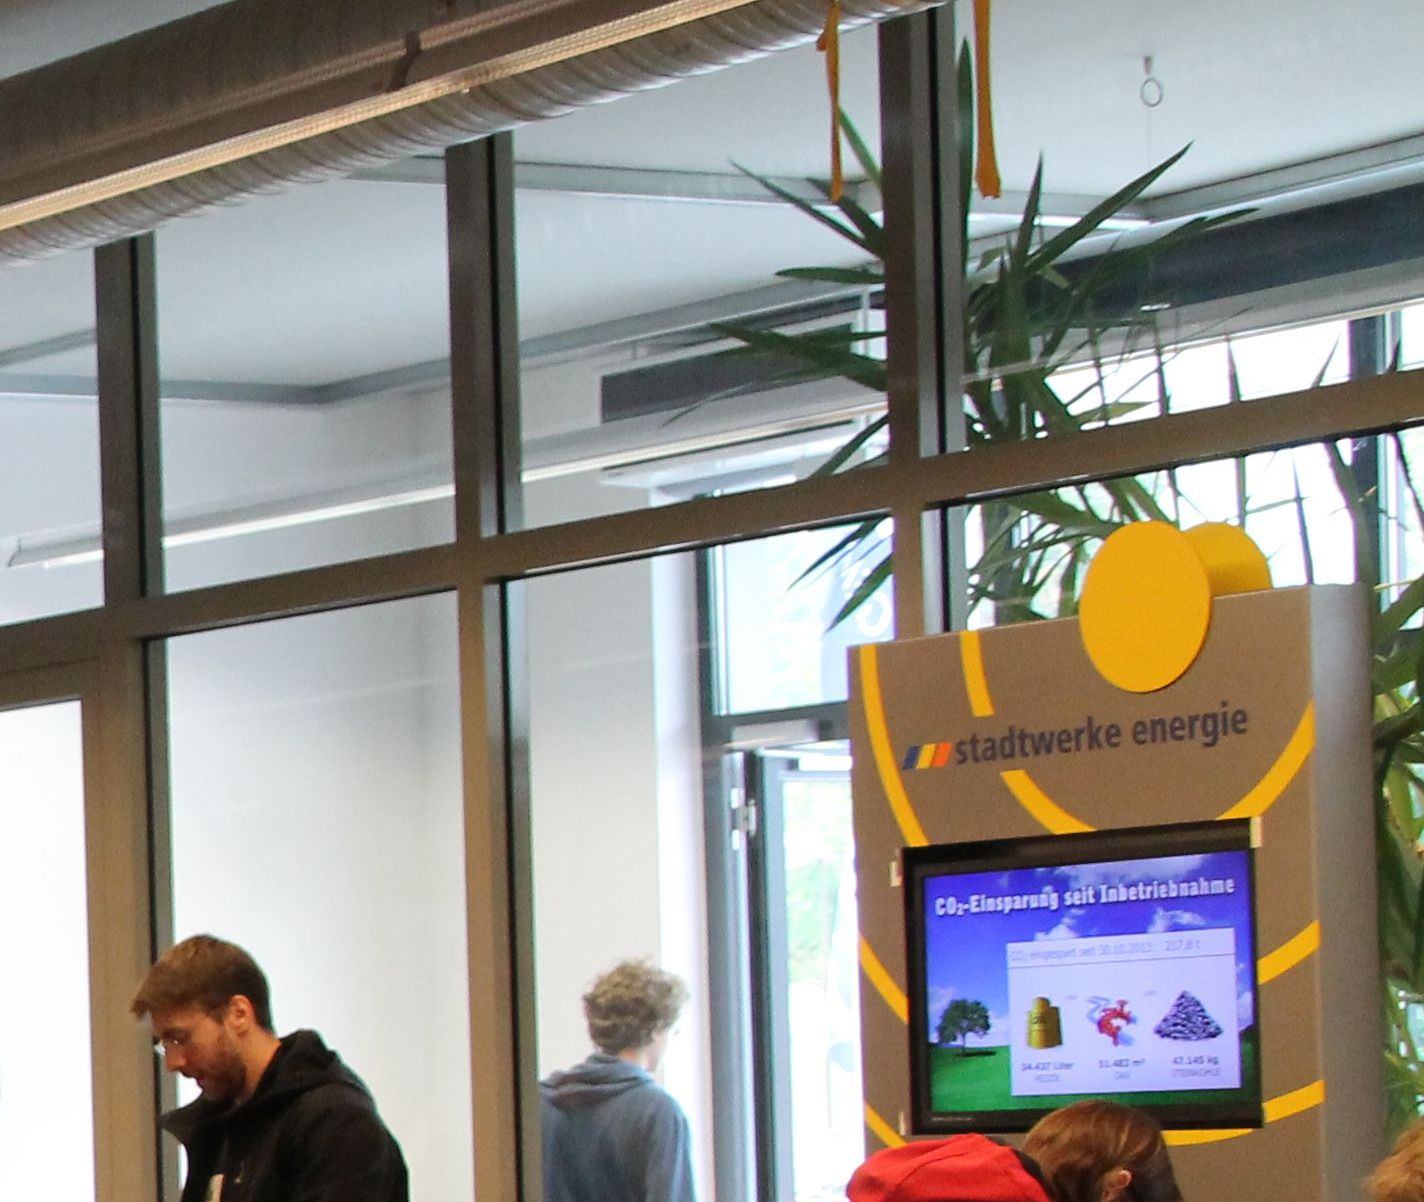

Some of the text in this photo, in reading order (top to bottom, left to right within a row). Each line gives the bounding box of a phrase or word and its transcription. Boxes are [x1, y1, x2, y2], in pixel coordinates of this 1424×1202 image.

[955, 700, 1249, 764] stadtwerke energie
[1064, 889, 1095, 906] seit
[1099, 876, 1235, 904] Inbetriebnahme
